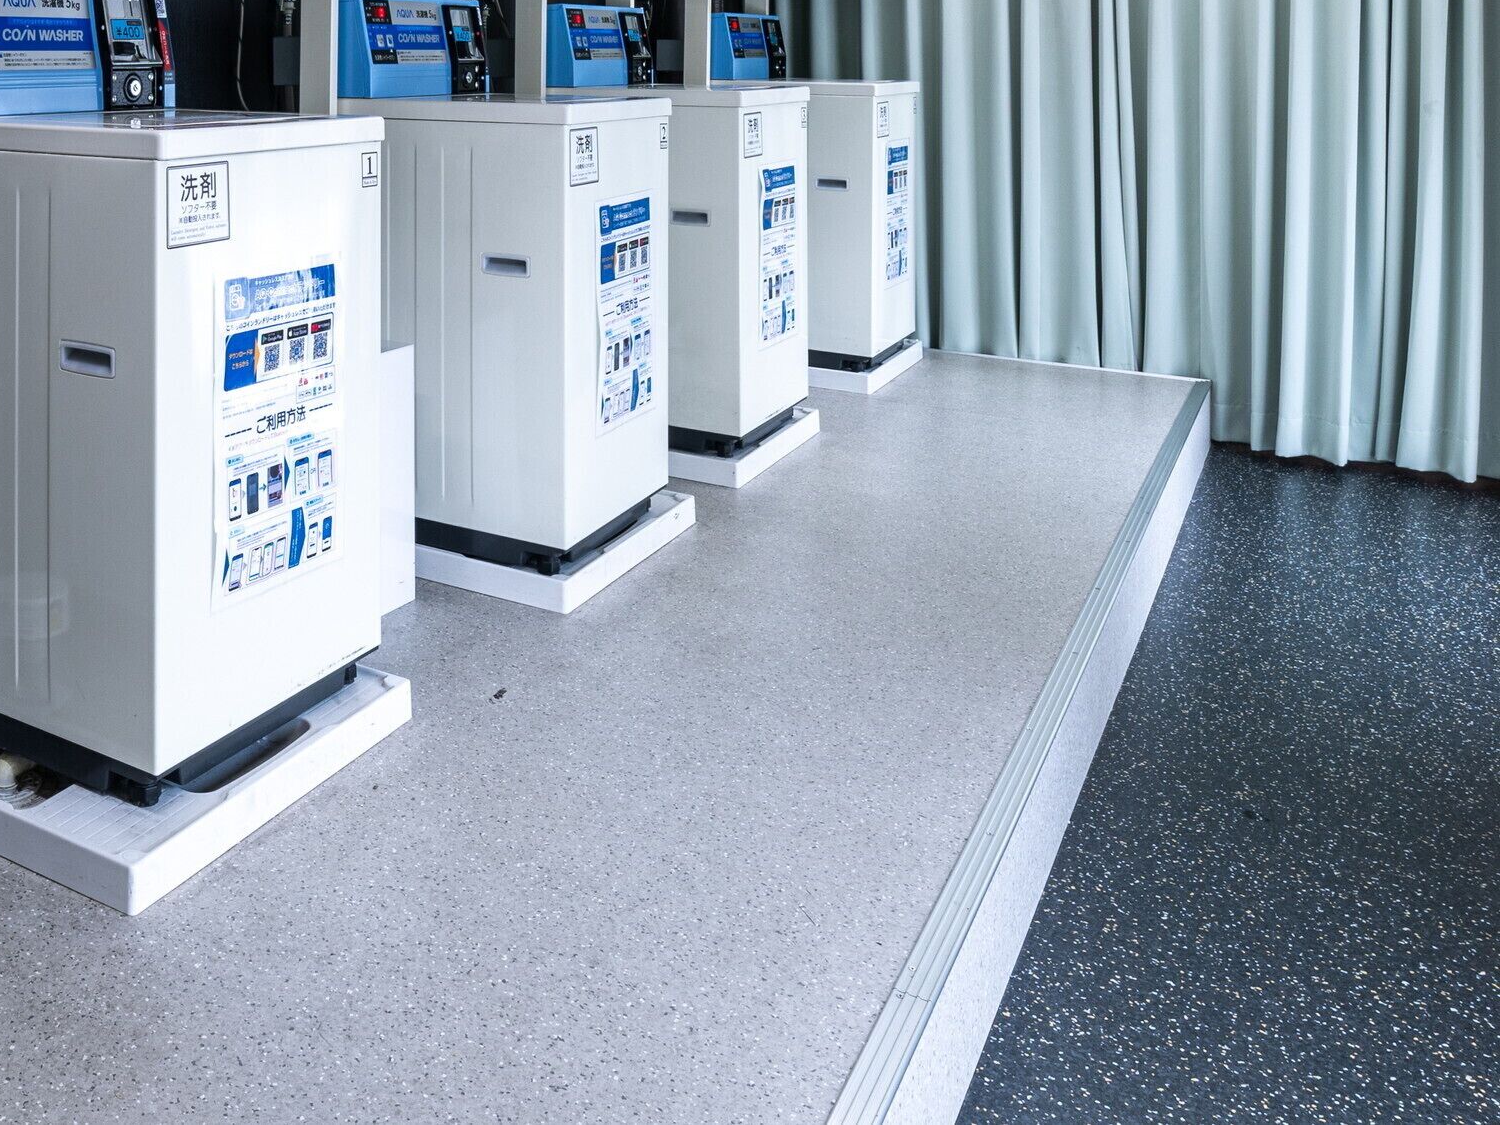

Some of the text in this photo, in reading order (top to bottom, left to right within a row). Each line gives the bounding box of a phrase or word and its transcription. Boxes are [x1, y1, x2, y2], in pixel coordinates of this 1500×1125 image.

[2, 25, 84, 42] COIN WASHER
[115, 26, 140, 38] ¥400
[366, 156, 373, 175] 1
[180, 171, 217, 202] 洗剤
[181, 200, 217, 215] ソフター不要
[256, 404, 306, 434] ご利用方法
